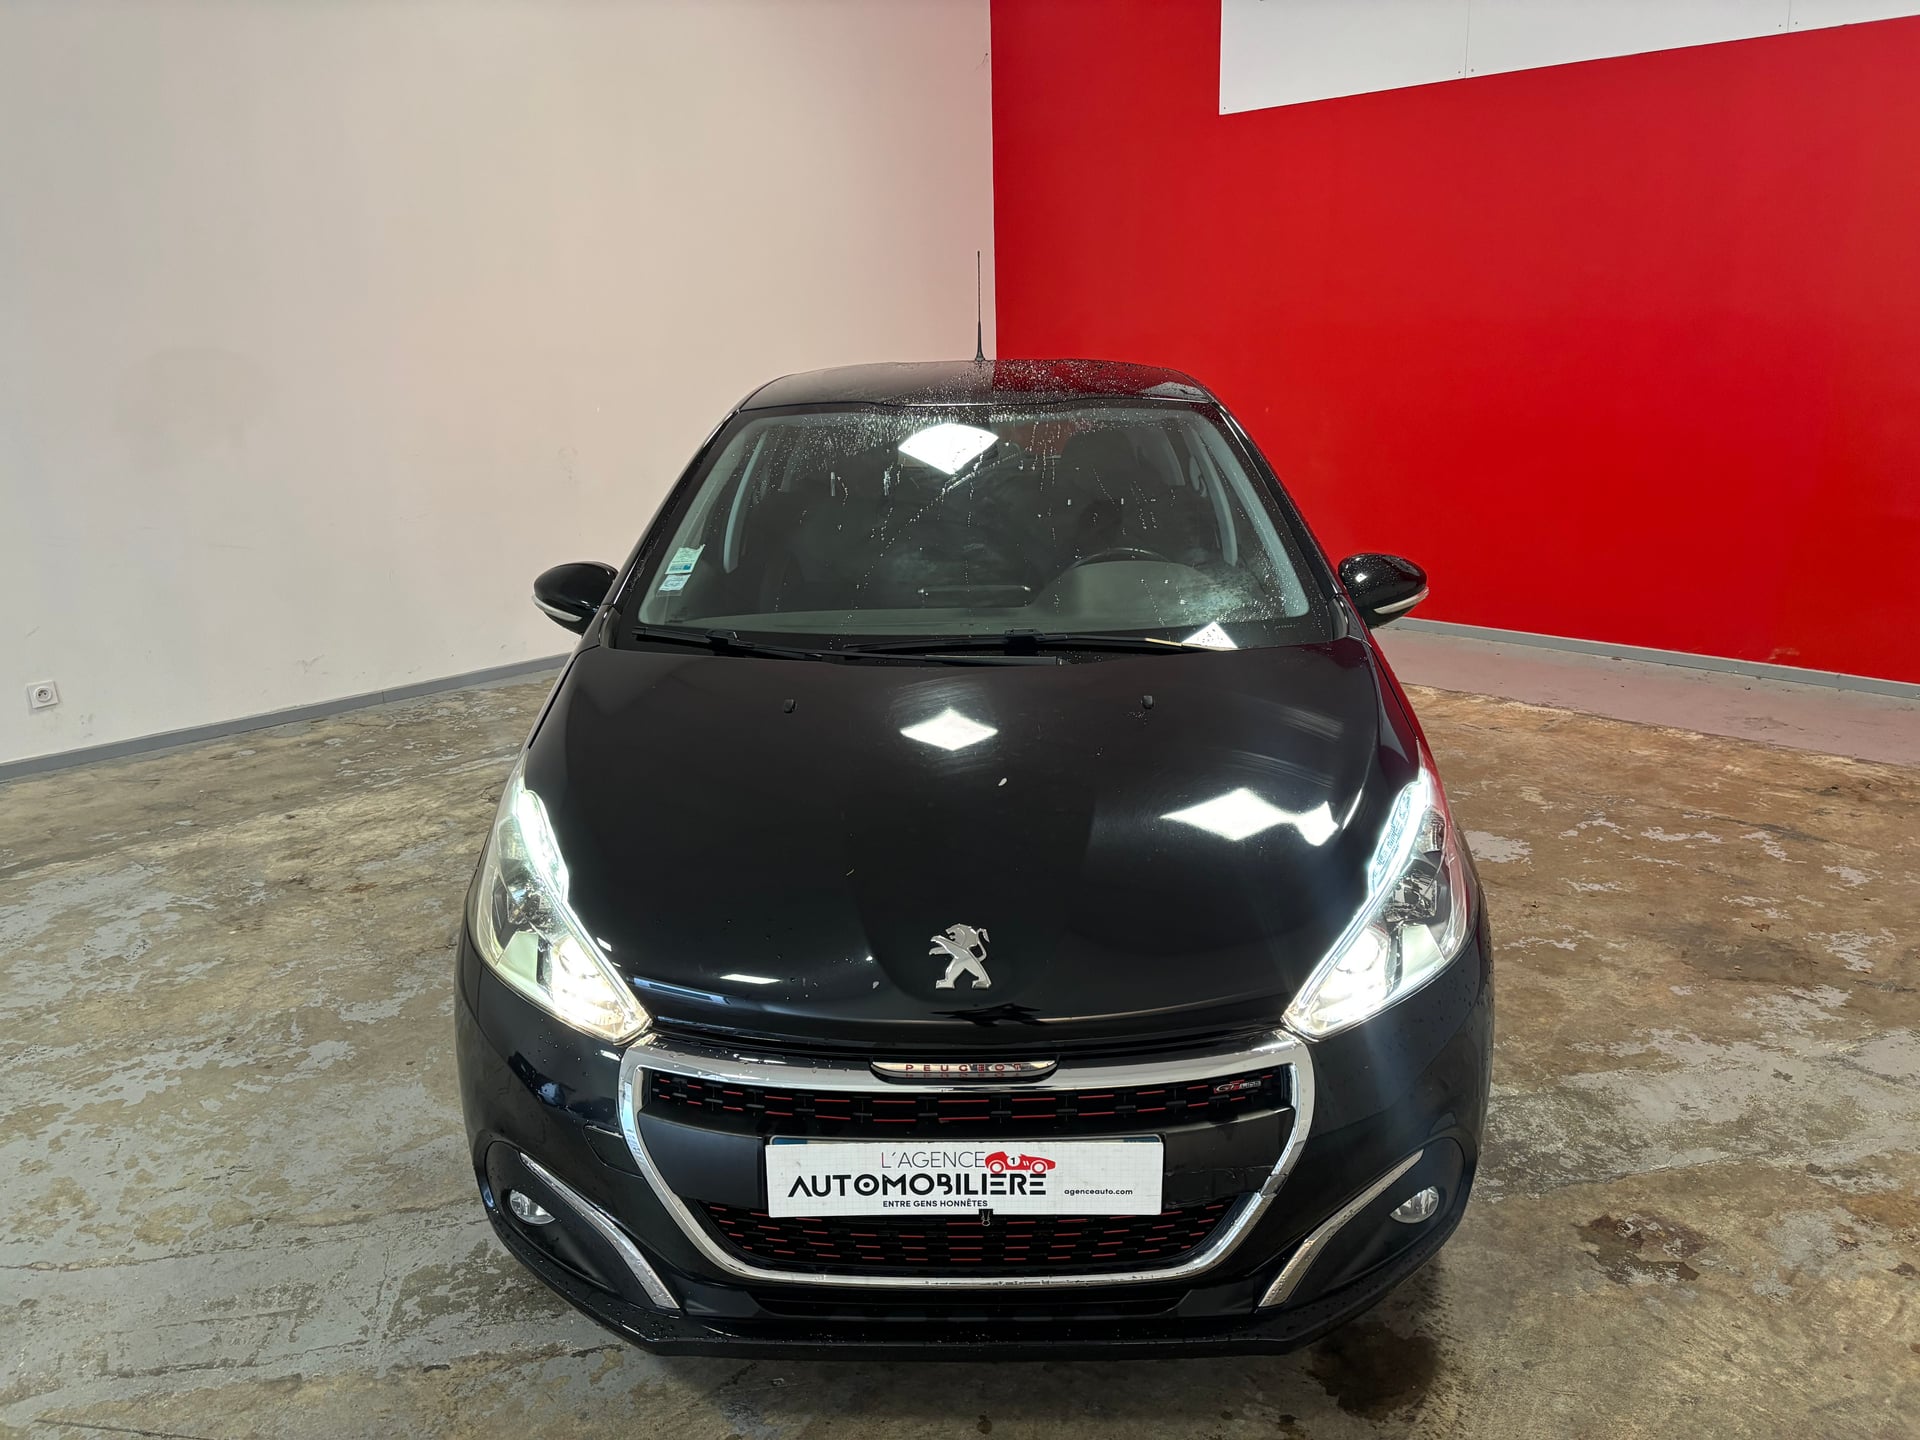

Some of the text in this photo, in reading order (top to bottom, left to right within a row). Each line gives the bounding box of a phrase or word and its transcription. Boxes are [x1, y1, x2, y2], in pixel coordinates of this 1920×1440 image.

[905, 1063, 1021, 1072] PEUGEOT
[881, 1151, 986, 1168] L'AGENCE
[1064, 1188, 1133, 1196] agenceauto.com
[940, 1198, 988, 1207] HONNÊTES
